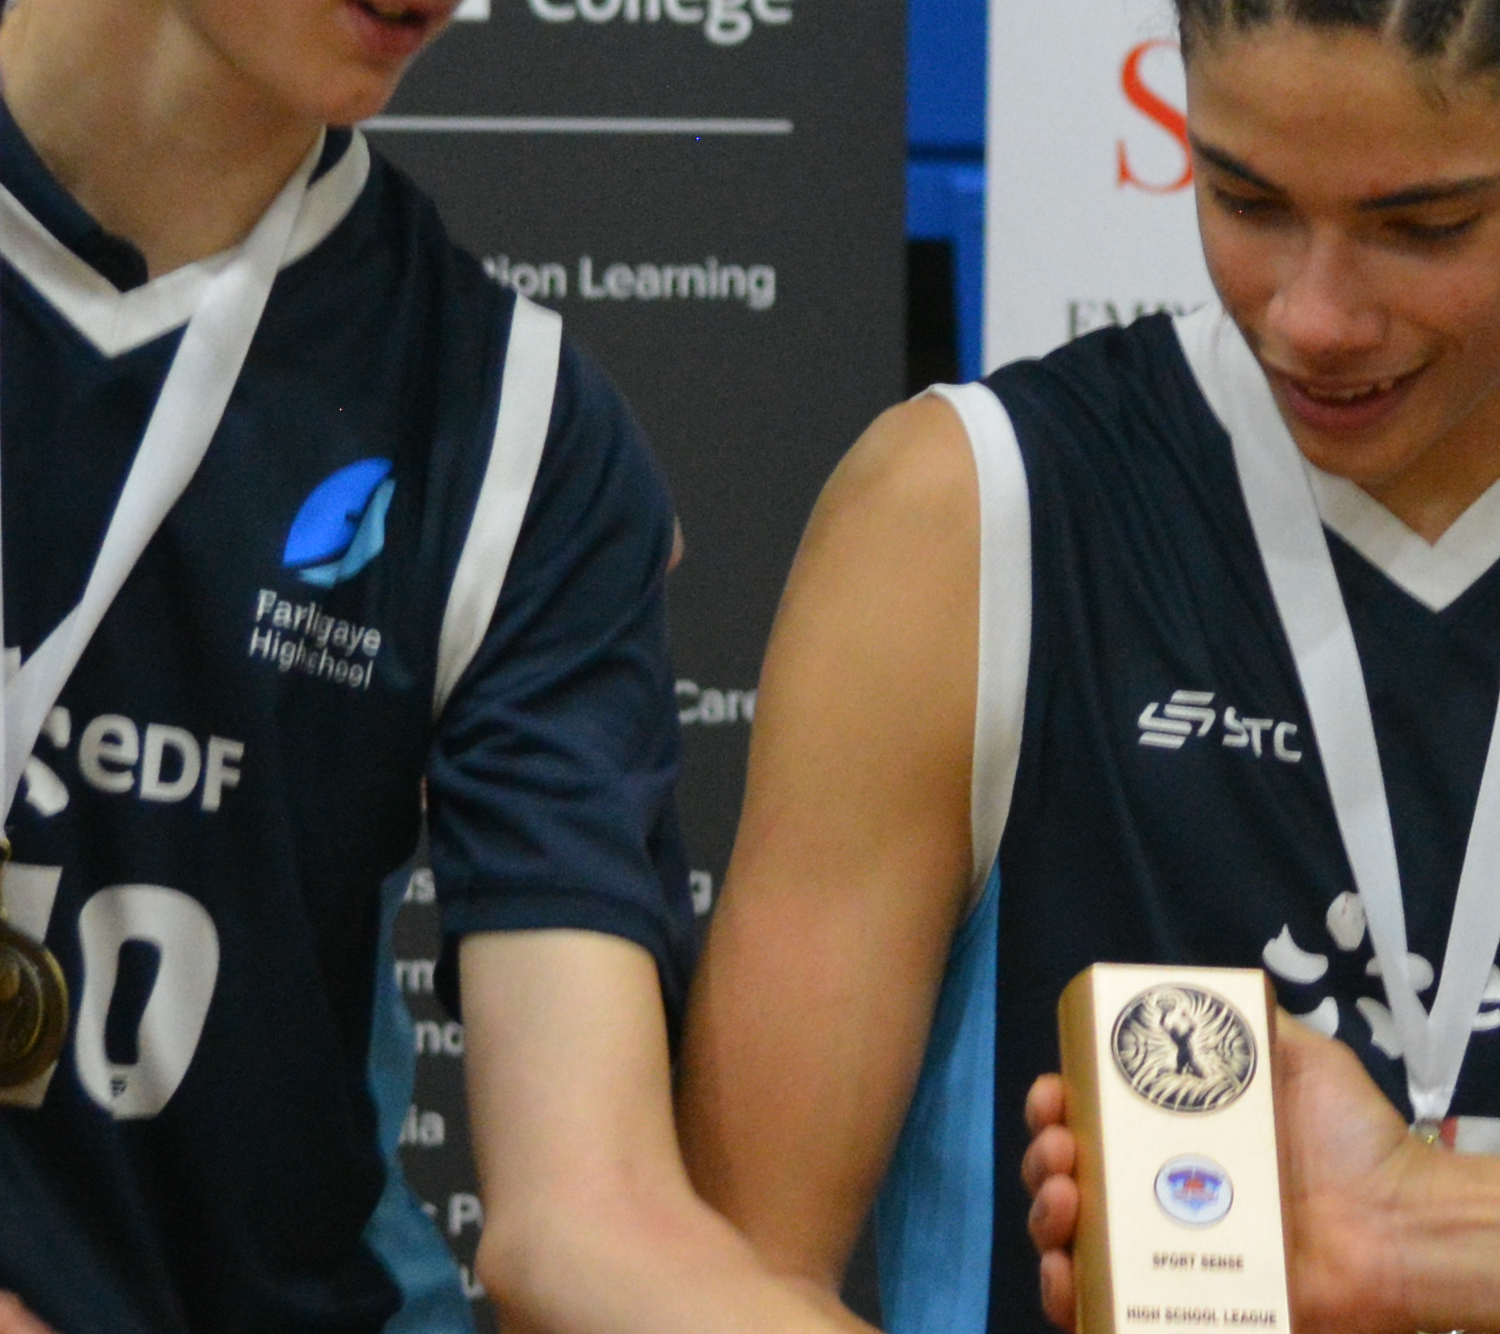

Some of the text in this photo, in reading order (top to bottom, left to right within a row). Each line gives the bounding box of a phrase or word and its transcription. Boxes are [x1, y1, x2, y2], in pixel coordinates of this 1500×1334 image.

[579, 255, 776, 311] Learning
[1222, 705, 1303, 763] STC
[1127, 1305, 1278, 1328] HIGH SCHOOL LEAGUE
